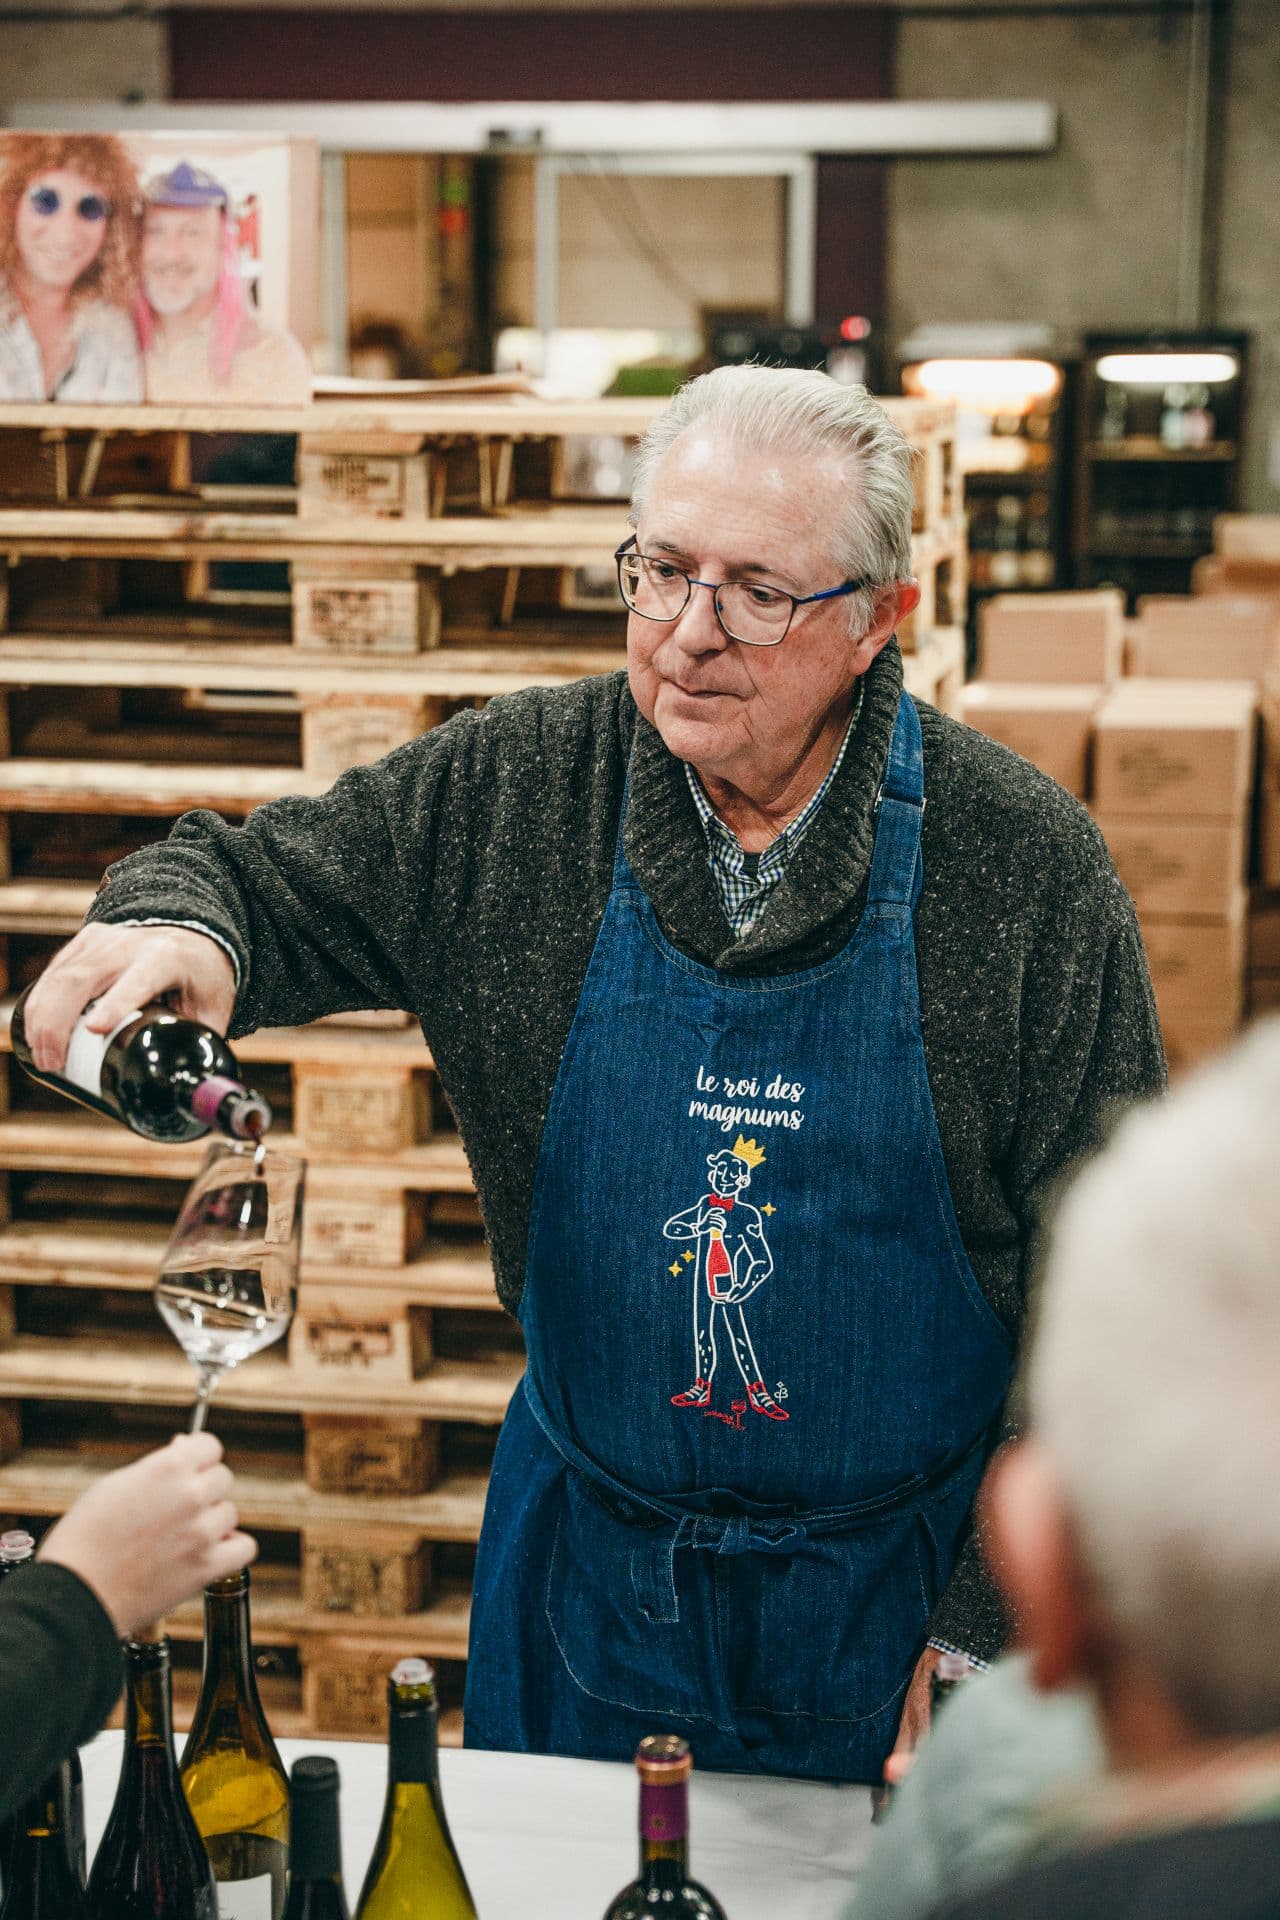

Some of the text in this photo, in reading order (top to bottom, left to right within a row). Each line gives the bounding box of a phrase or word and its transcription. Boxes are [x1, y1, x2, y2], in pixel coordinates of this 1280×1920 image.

[723, 1077, 760, 1098] roi
[765, 1074, 805, 1103] des
[688, 1100, 804, 1132] magnums
